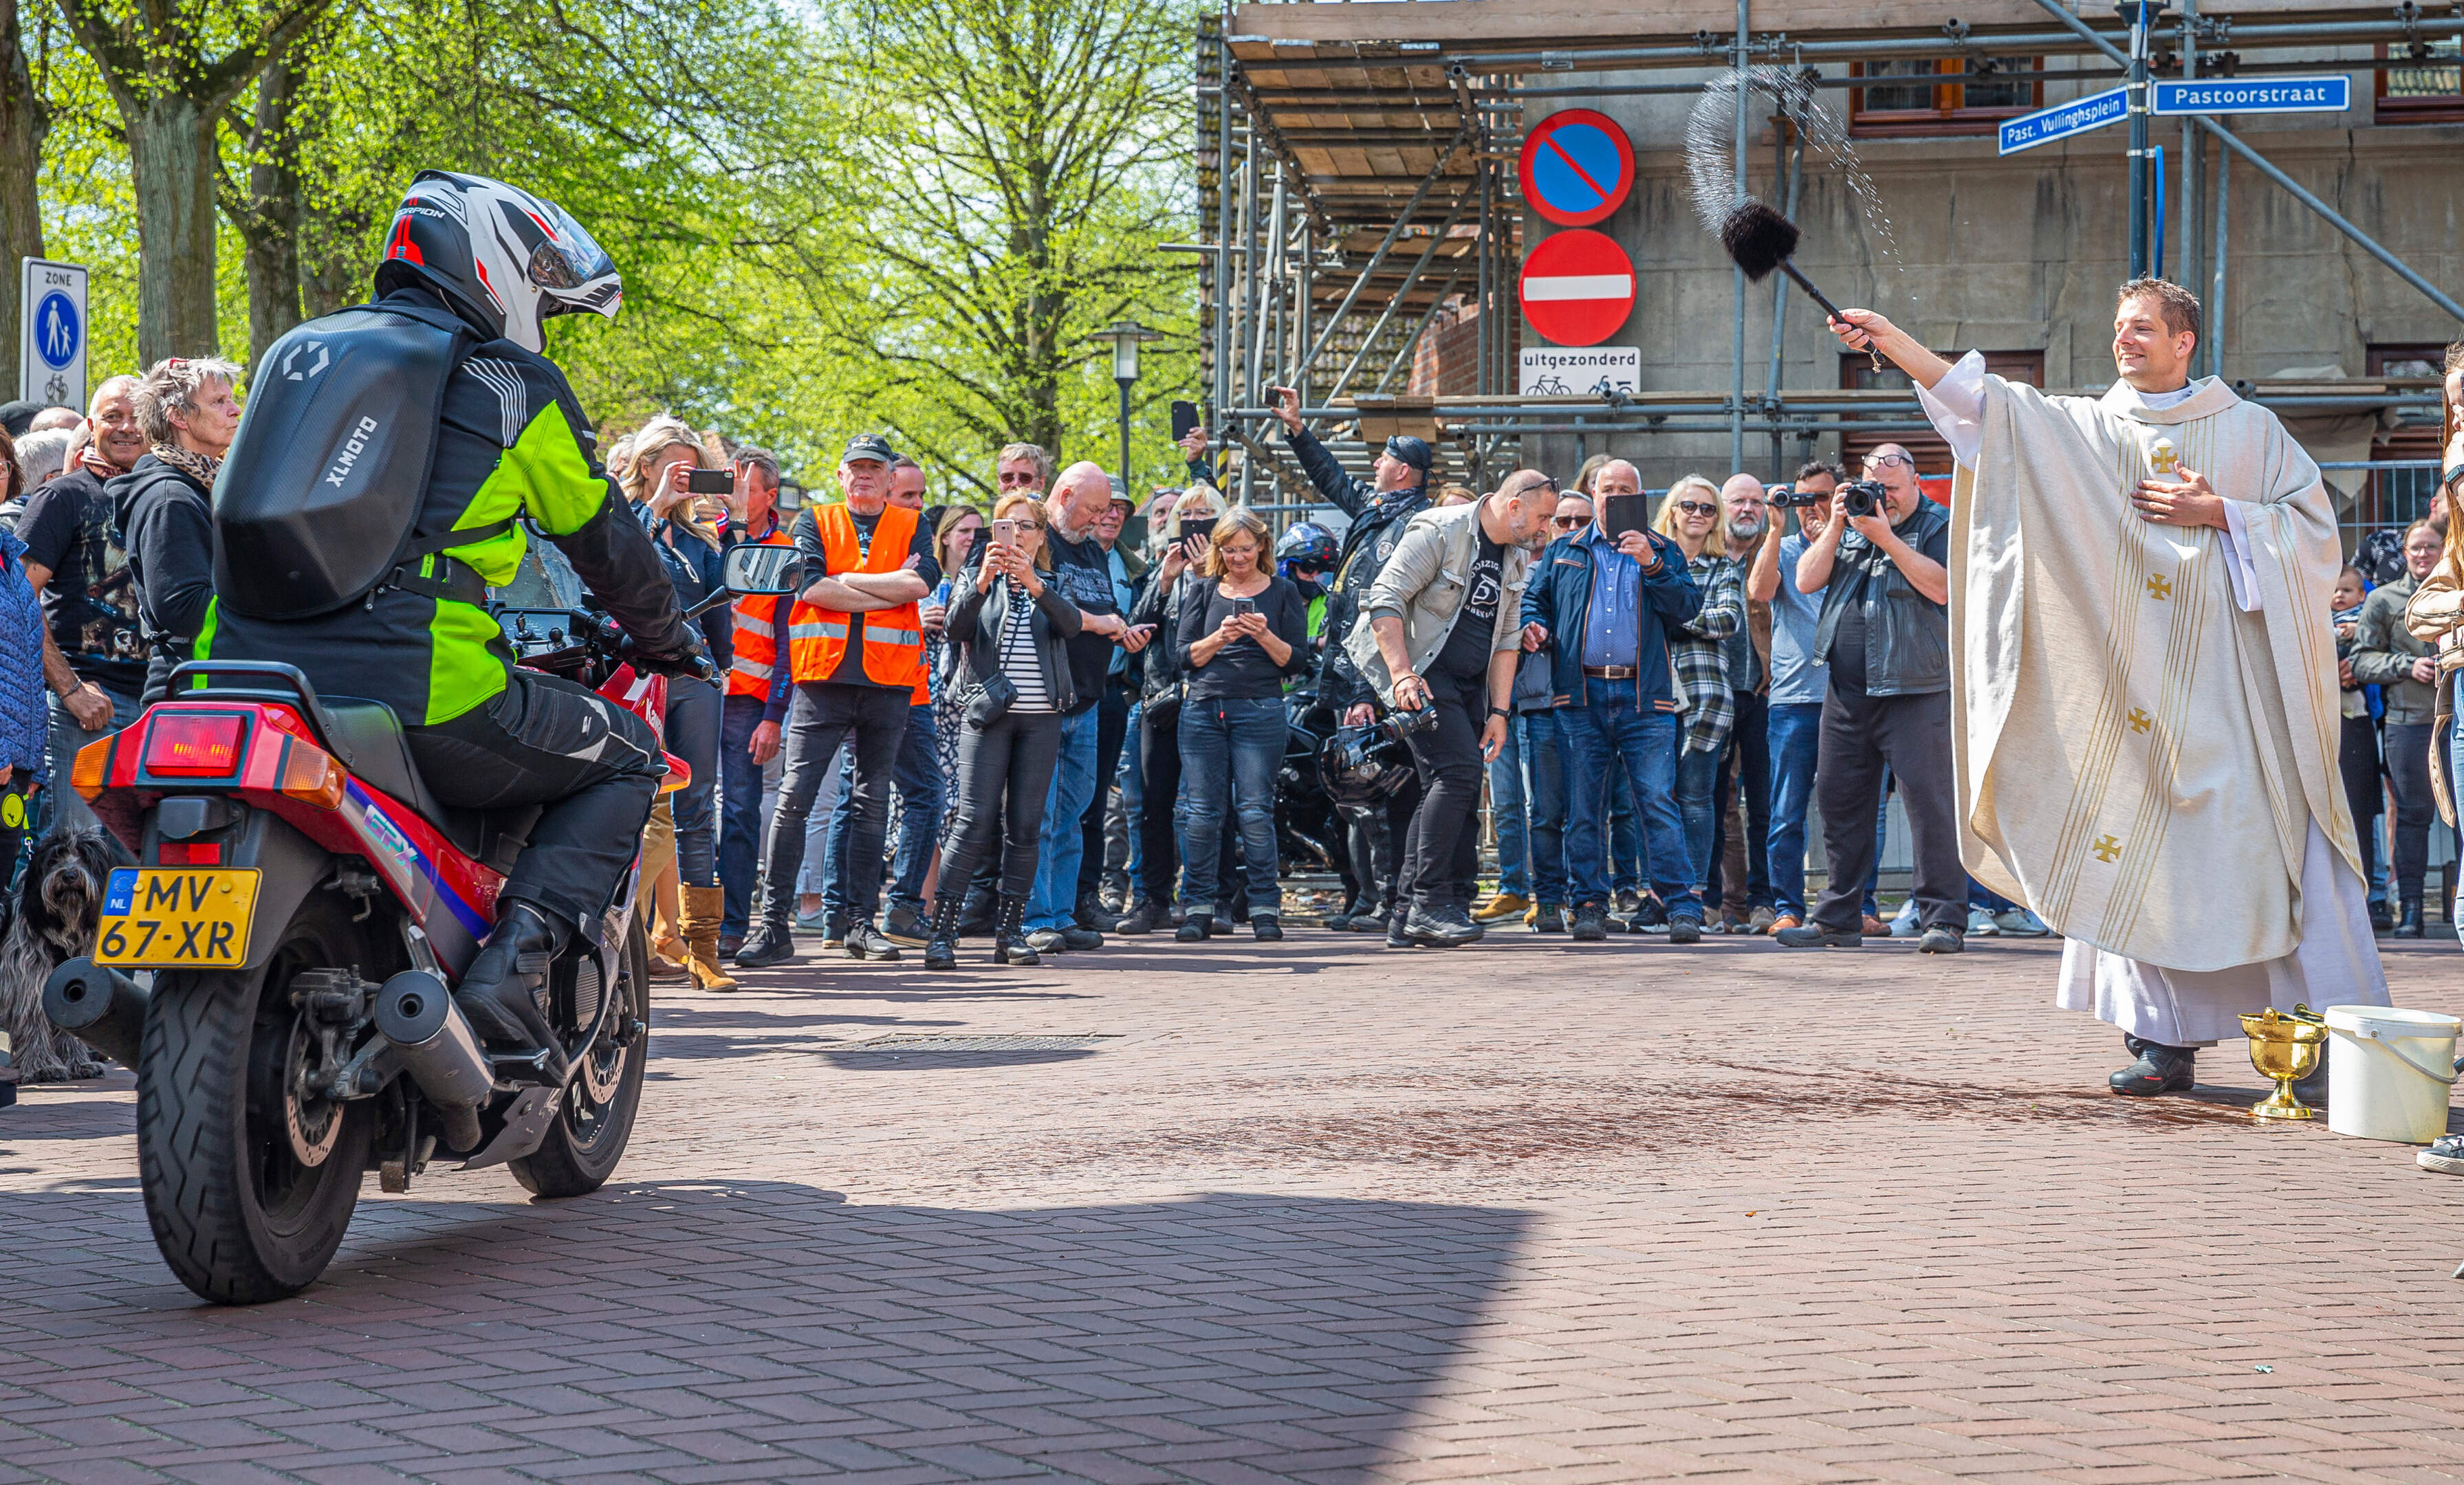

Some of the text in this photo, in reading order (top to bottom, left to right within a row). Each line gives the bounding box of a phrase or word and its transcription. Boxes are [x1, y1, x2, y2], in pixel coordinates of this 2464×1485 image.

[2175, 87, 2326, 104] Pastoorstraat
[2007, 98, 2119, 144] Past. Vullinghsplein
[395, 207, 446, 219] CORPION
[45, 272, 72, 286] ZONE
[1524, 353, 1635, 370] uitgezonderd
[325, 416, 378, 487] XLMOTO
[364, 804, 418, 877] GPX
[110, 898, 127, 910] NL
[145, 876, 215, 912] MV
[101, 920, 235, 958] 67-XR
